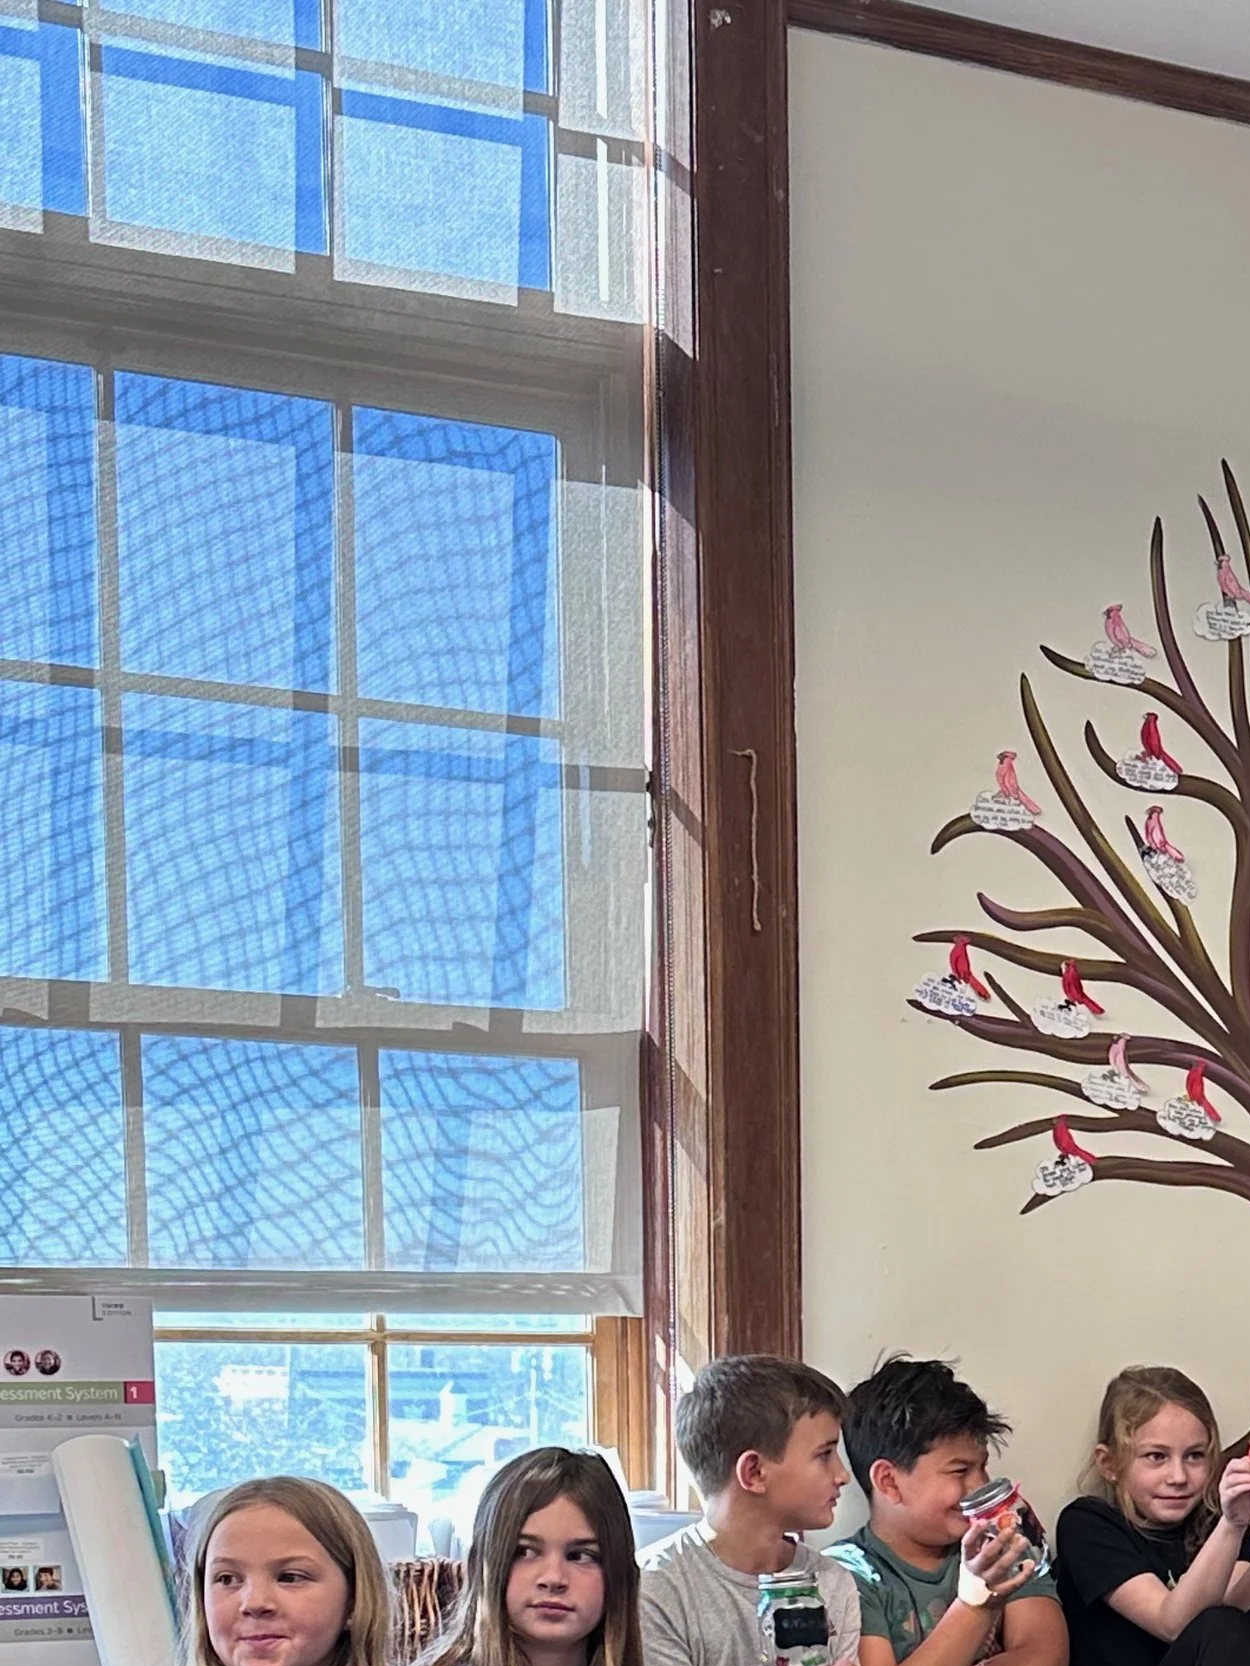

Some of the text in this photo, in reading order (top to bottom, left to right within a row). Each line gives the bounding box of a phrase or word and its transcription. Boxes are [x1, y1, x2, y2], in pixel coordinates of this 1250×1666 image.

[0, 1386, 138, 1402] essment System 1
[15, 1414, 45, 1422] Grades
[0, 1601, 88, 1616] essment Sys
[14, 1628, 45, 1637] Grades
